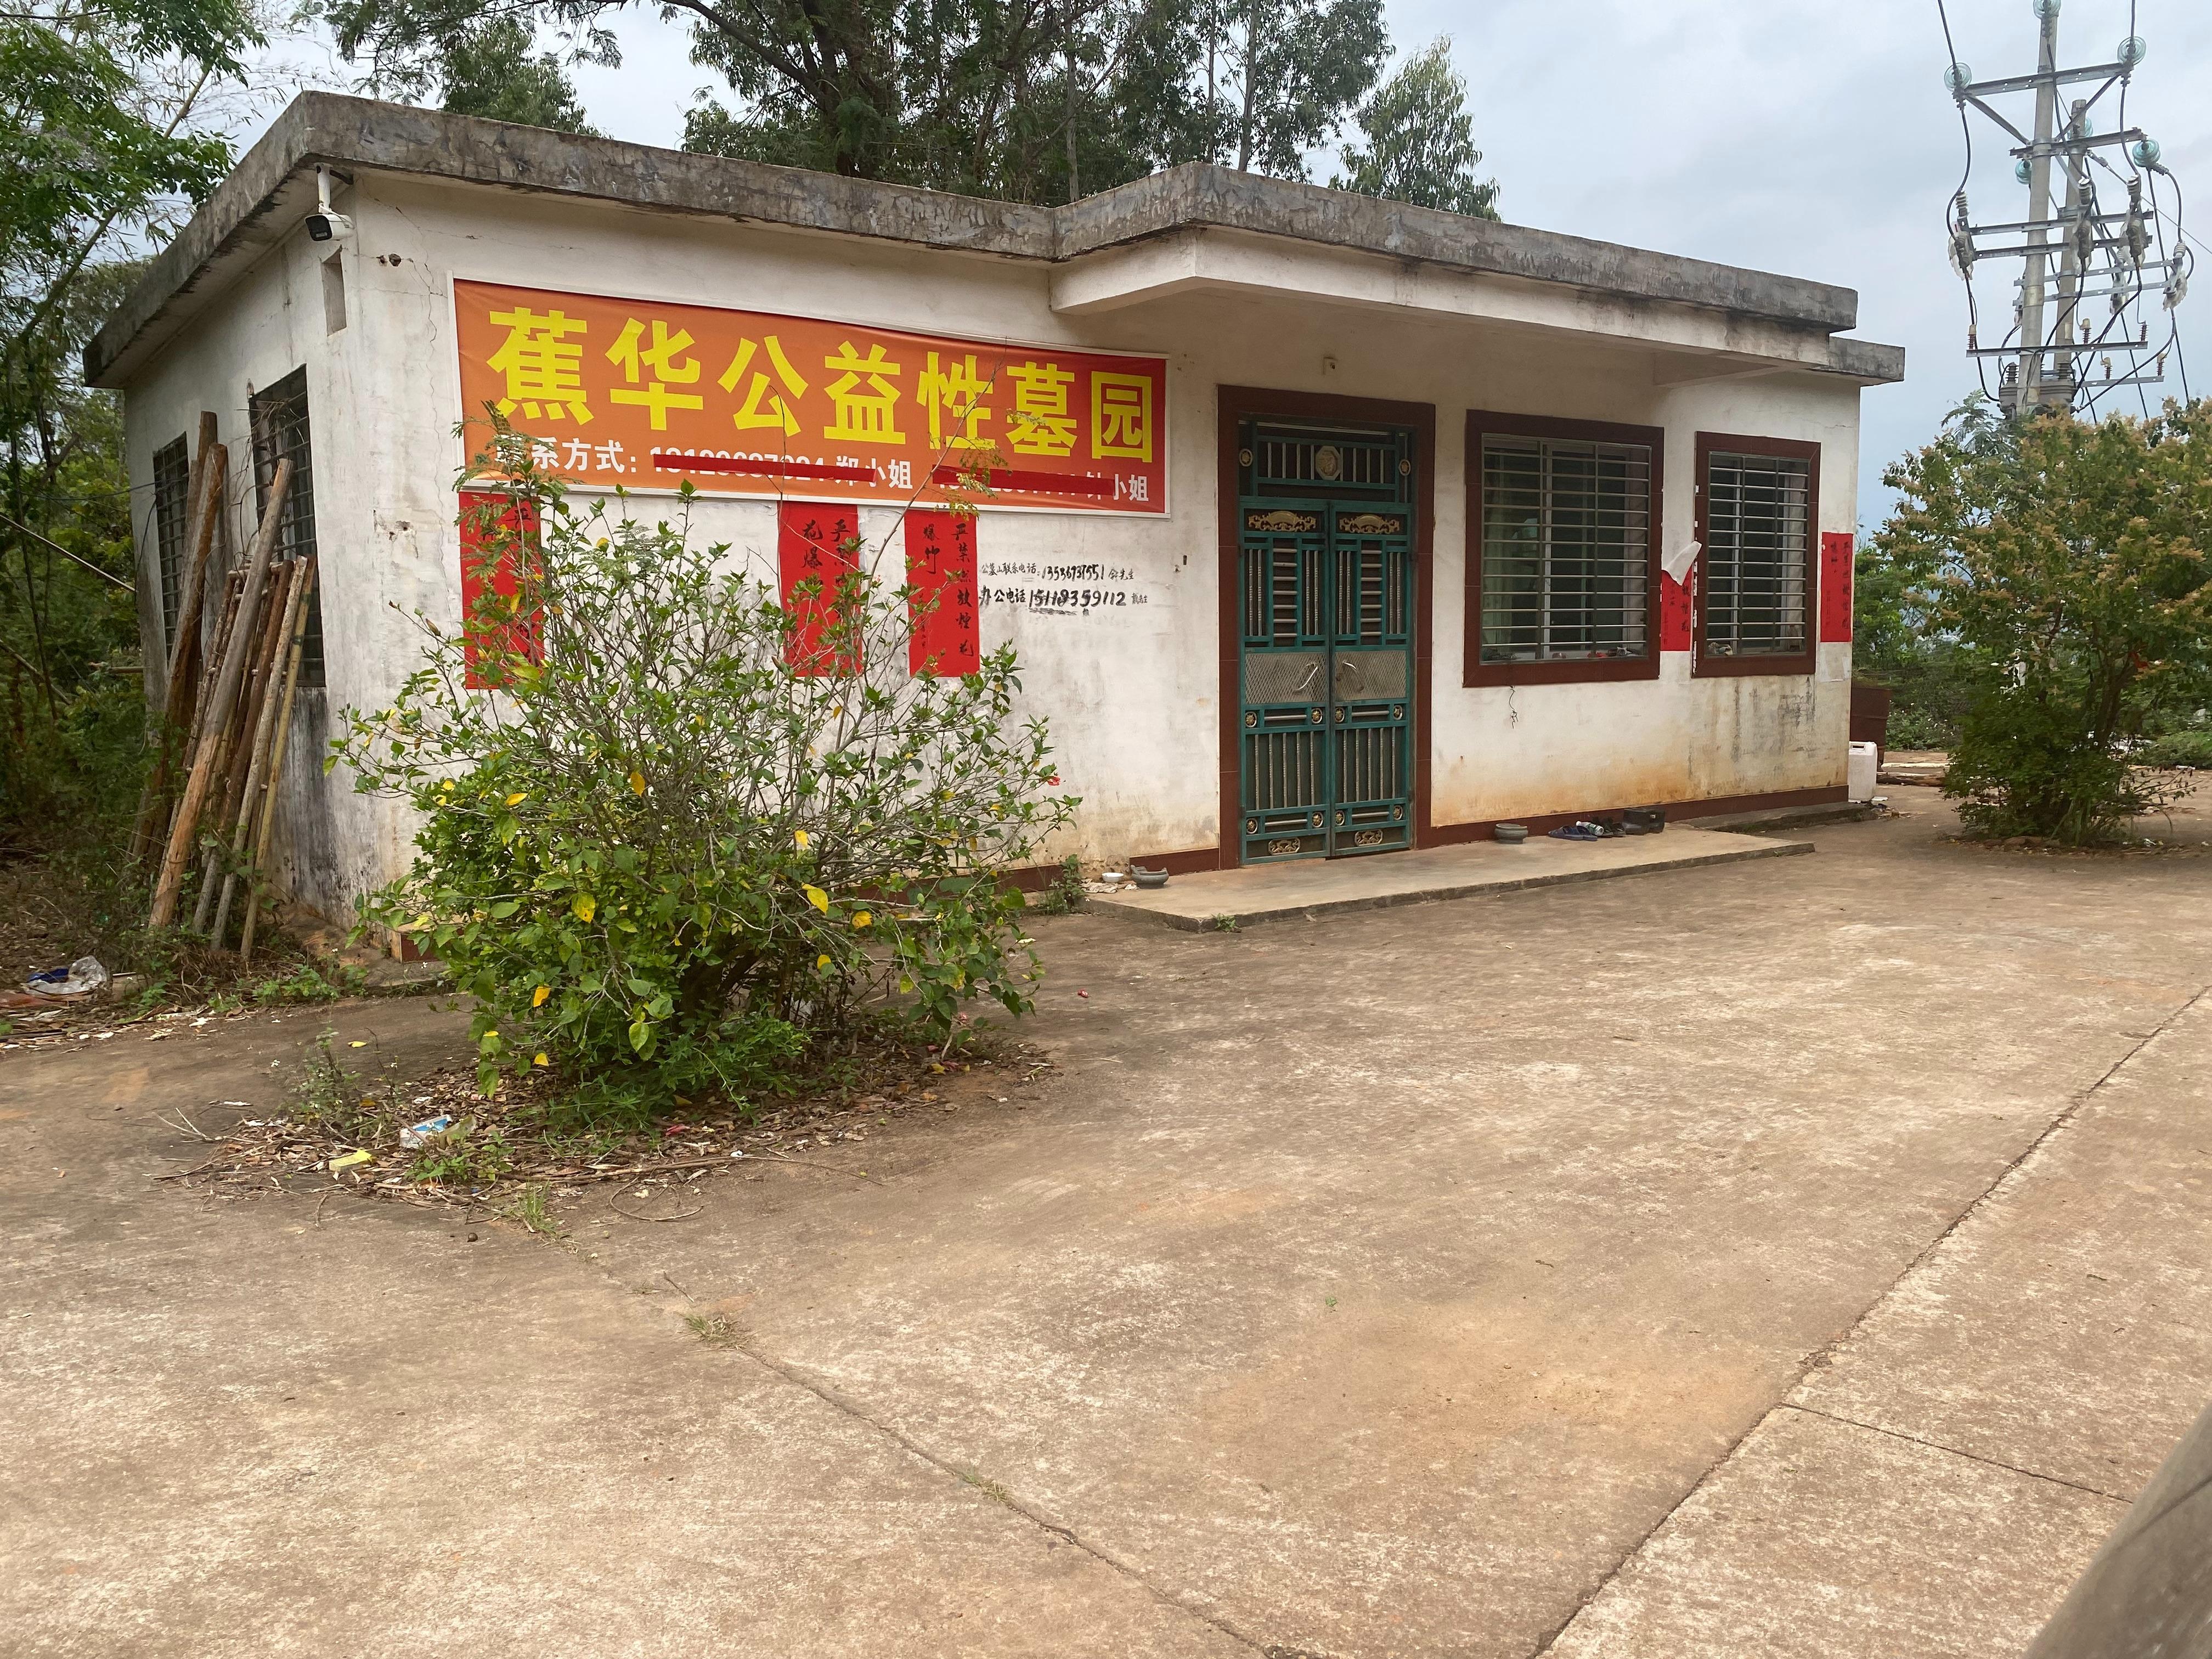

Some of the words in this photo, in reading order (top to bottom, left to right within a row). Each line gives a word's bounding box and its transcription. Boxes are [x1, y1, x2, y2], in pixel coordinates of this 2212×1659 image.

[487, 307, 1153, 462] 蕉华公益性墓园
